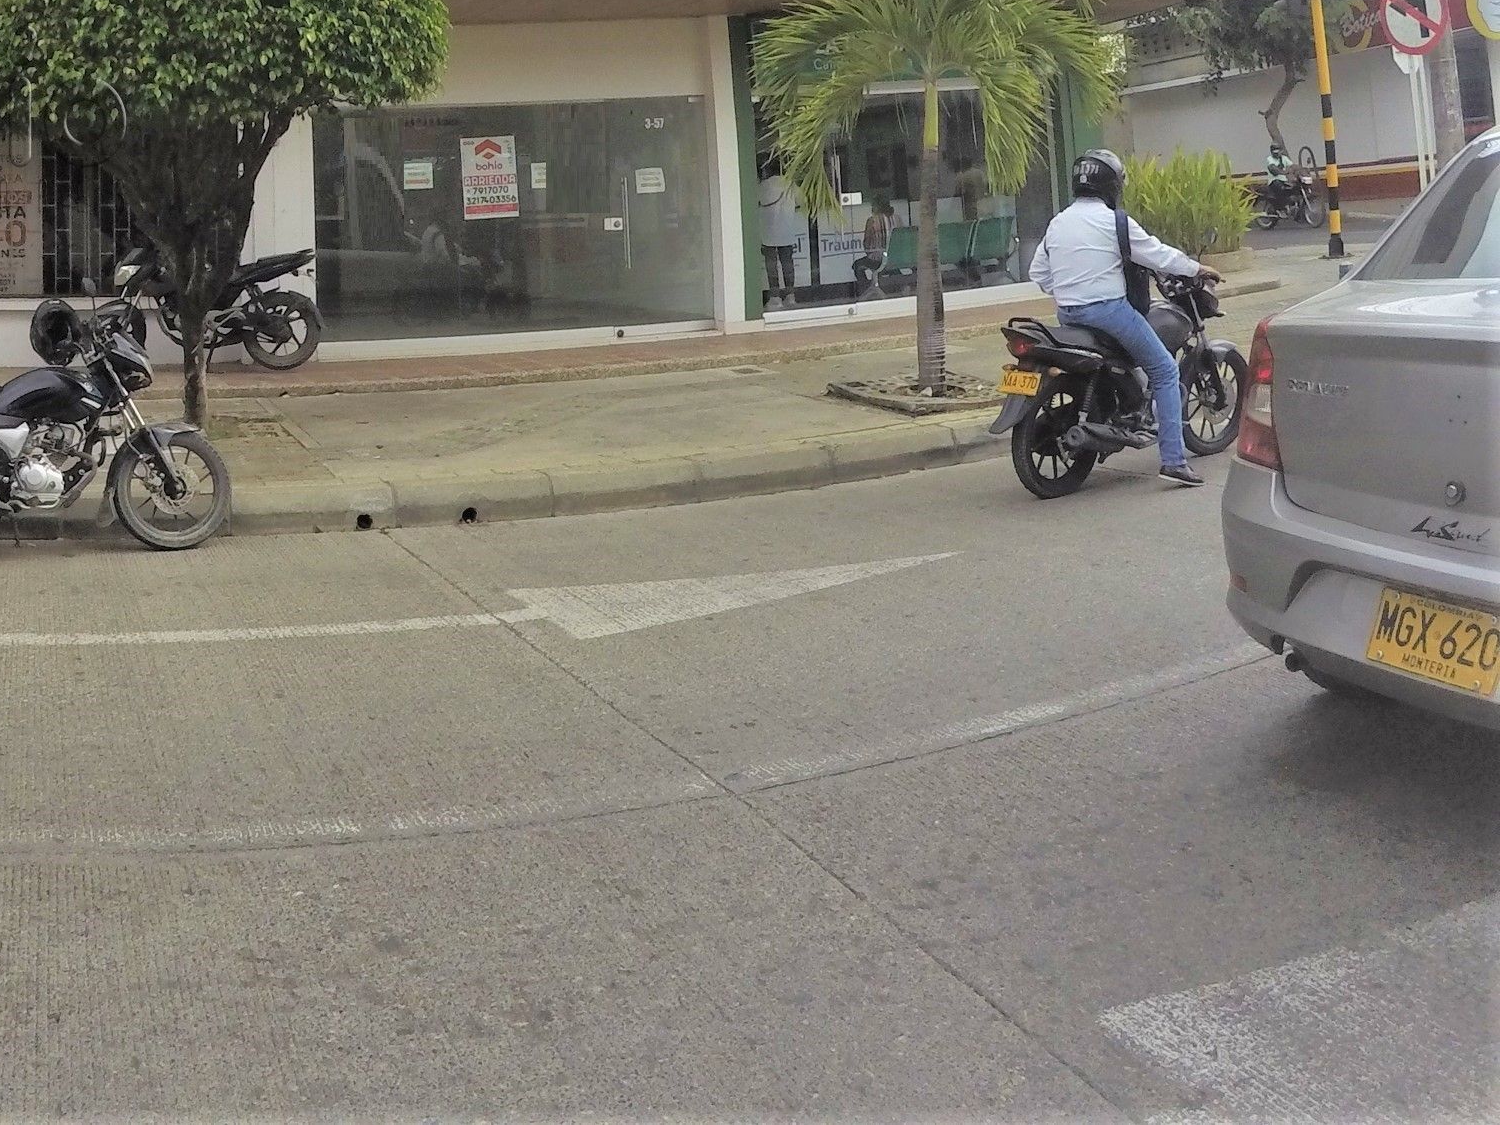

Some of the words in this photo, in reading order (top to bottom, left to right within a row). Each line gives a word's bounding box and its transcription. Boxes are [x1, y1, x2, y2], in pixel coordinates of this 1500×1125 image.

[644, 117, 665, 129] 3-57
[464, 174, 516, 186] ARRIENDA
[473, 185, 509, 195] 7917070
[466, 194, 517, 205] 3217403356
[820, 238, 863, 253] Traum
[1375, 599, 1438, 655] MGX
[1438, 619, 1500, 673] 620
[1401, 653, 1458, 680] MONTERIA
